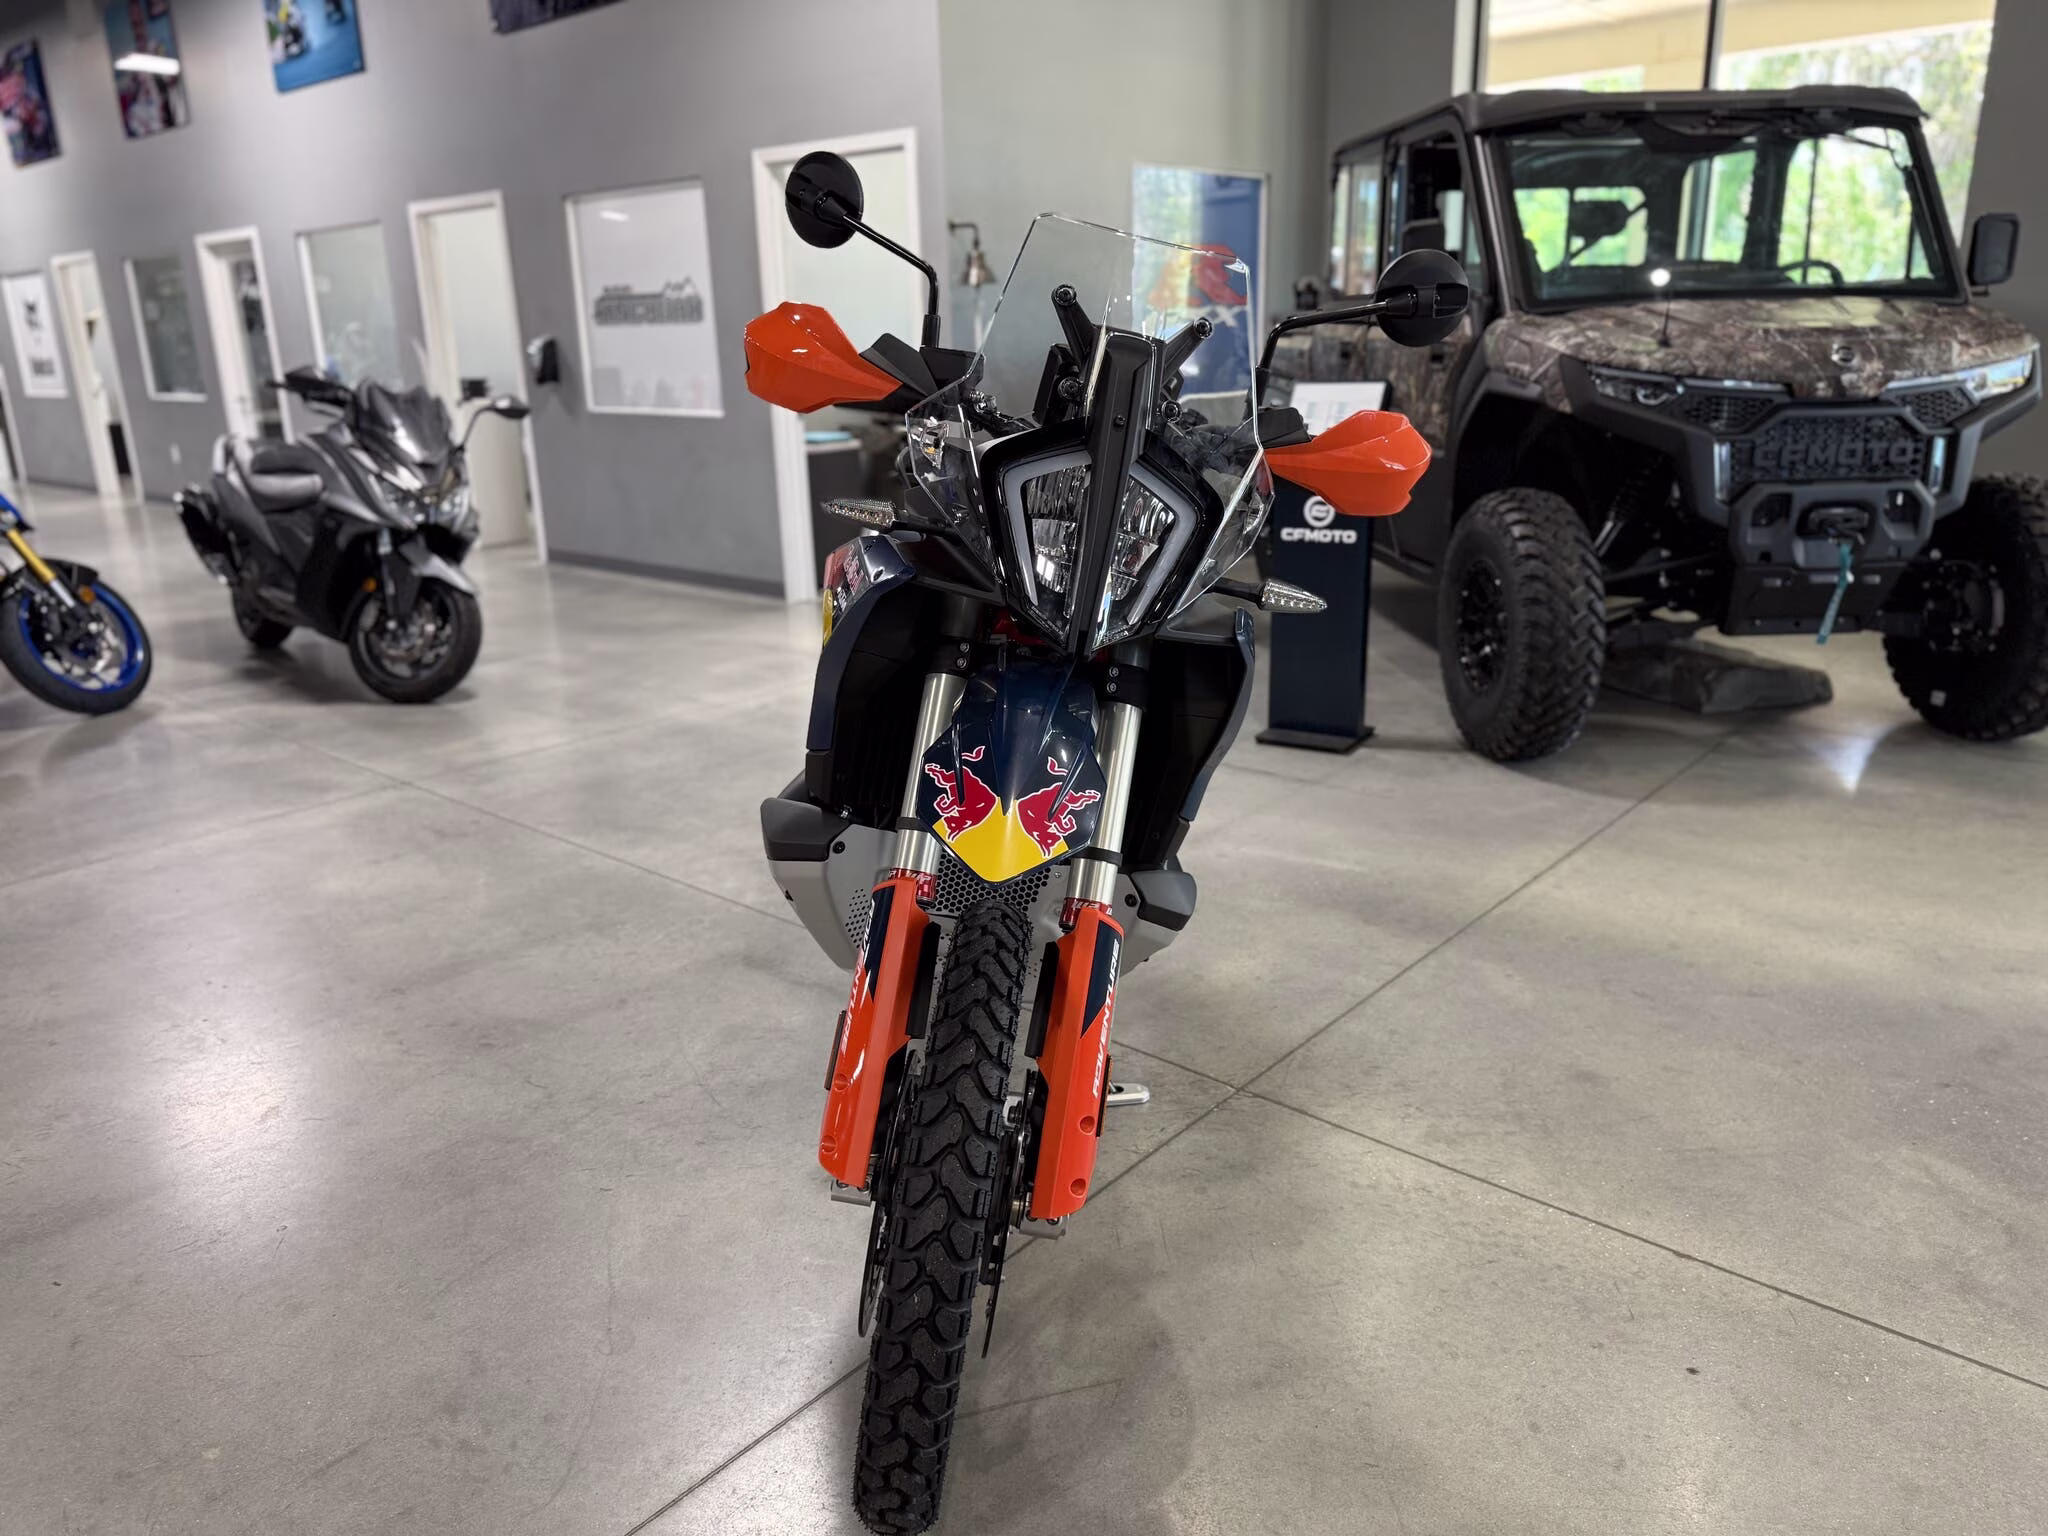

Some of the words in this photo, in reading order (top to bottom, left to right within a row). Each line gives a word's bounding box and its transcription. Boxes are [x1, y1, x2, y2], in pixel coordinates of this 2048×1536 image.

[1753, 439, 1915, 467] CFMOTO
[1281, 527, 1358, 544] CFMOTO
[1092, 938, 1120, 1099] ADVENTURE
